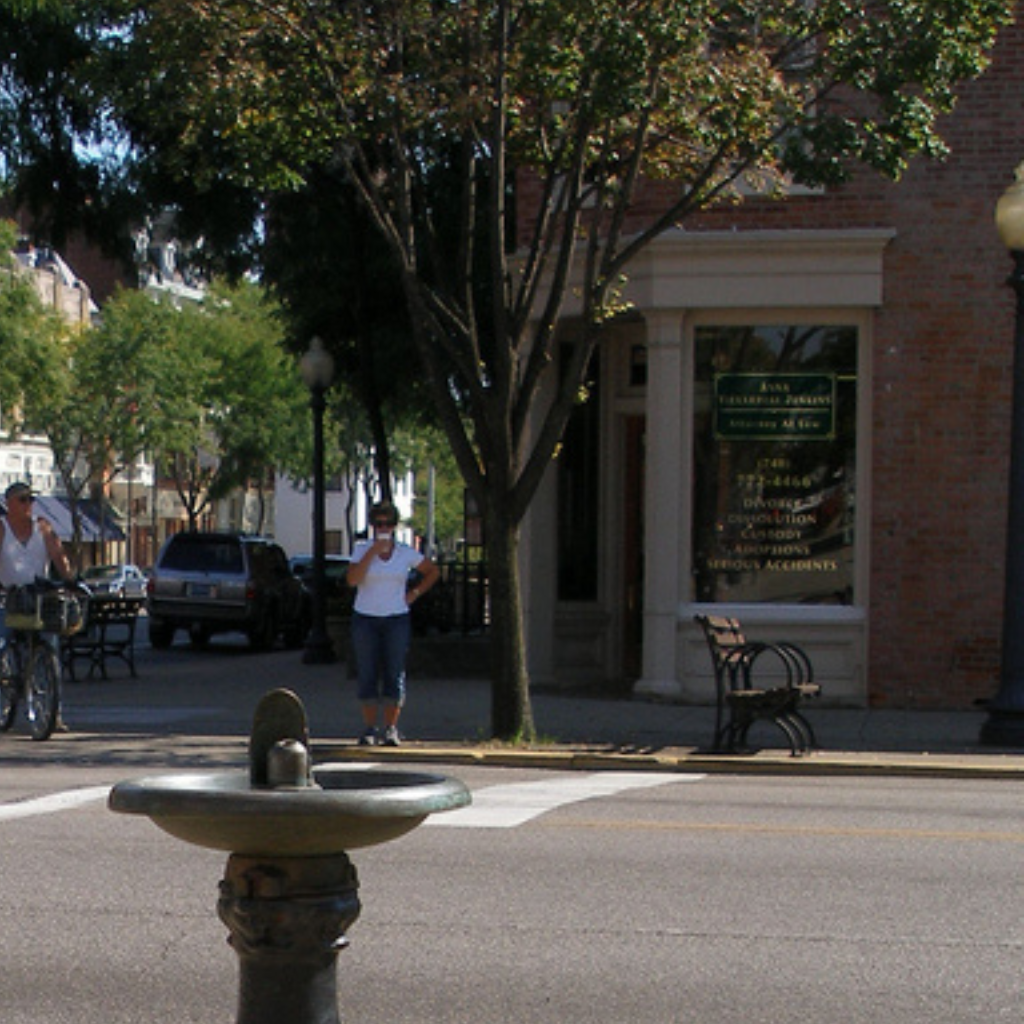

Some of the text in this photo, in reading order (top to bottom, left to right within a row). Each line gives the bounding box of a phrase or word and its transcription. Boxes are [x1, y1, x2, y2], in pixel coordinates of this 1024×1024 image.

[743, 498, 804, 508] DIVORCE
[727, 513, 817, 524] DISSOLUTION
[741, 529, 802, 540] CUSTODY
[734, 544, 811, 555] ADOPTIONS
[706, 558, 838, 571] SERIOUS ACCIDENTS
